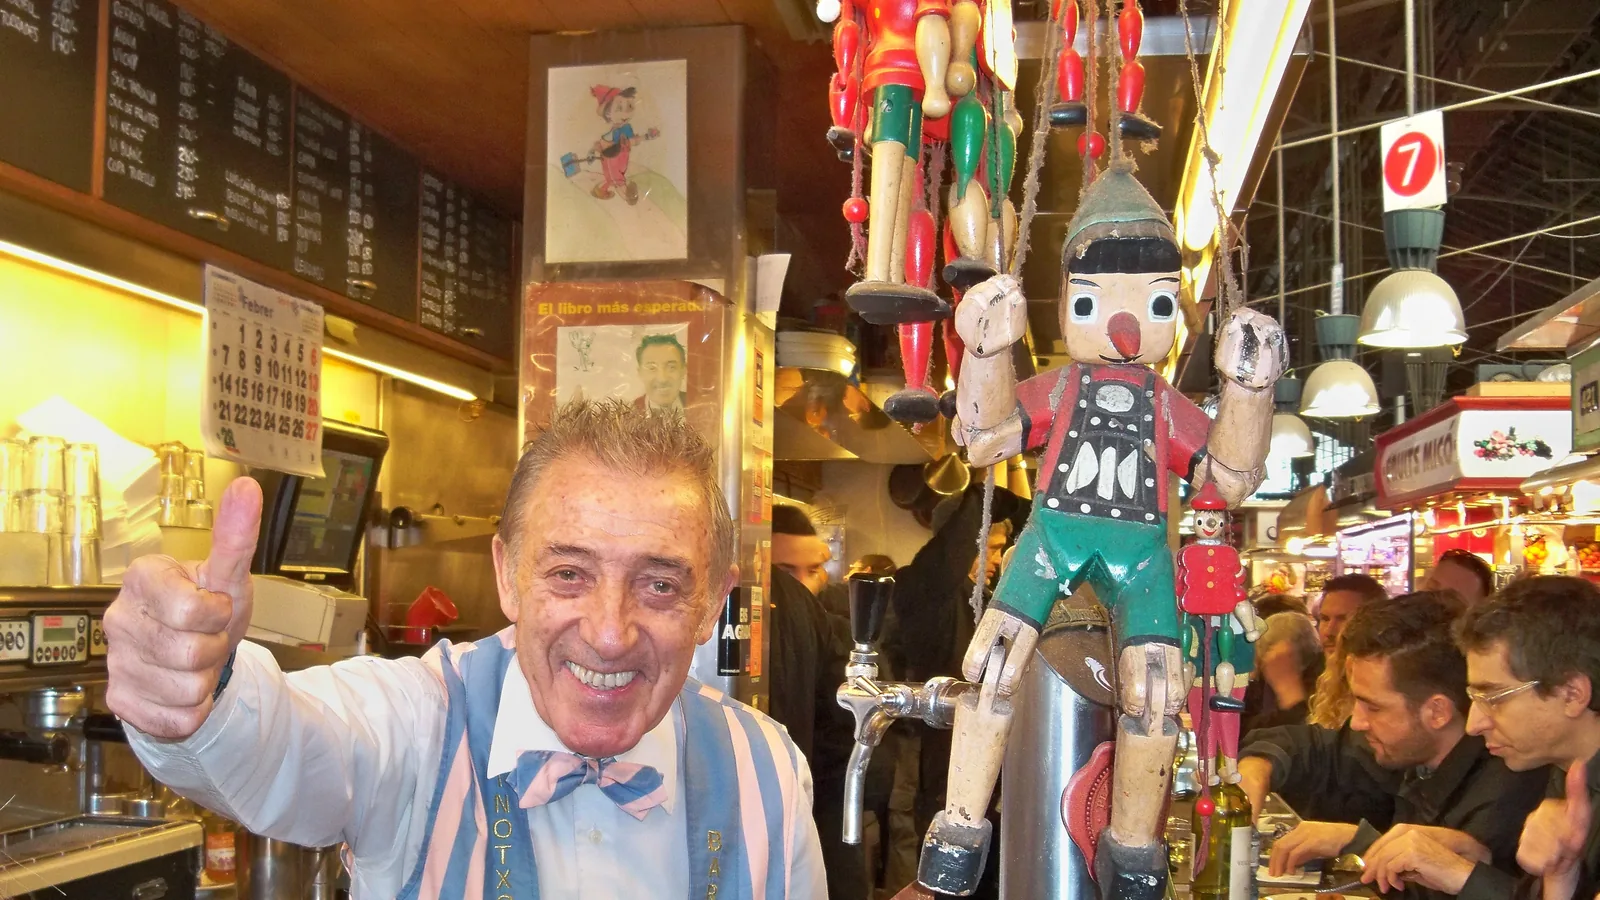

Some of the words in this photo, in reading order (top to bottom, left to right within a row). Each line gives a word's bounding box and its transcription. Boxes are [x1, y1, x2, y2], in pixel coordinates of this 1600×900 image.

[1397, 141, 1422, 187] 7
[240, 293, 275, 319] Febrer
[538, 303, 553, 315] El
[558, 302, 593, 315] libro
[597, 301, 629, 314] más
[239, 323, 245, 344] 1
[255, 329, 263, 350] 2
[270, 333, 277, 354] 3
[284, 338, 291, 358] 4
[297, 343, 304, 363] 5
[222, 344, 230, 366] 7
[239, 348, 246, 370] 8
[254, 354, 262, 375] 9
[268, 358, 280, 380] 10
[281, 363, 292, 385] 11
[295, 368, 307, 389] 12
[219, 371, 232, 394] 14
[235, 376, 248, 398] 15
[251, 381, 264, 402] 16
[266, 384, 279, 406] 17
[281, 388, 293, 410] 18
[294, 392, 306, 413] 19
[219, 400, 231, 422] 21
[234, 403, 248, 425] 22
[249, 407, 262, 429] 23
[264, 411, 276, 433] 24
[278, 415, 291, 436] 25
[292, 418, 305, 439] 26
[305, 421, 319, 441] 27
